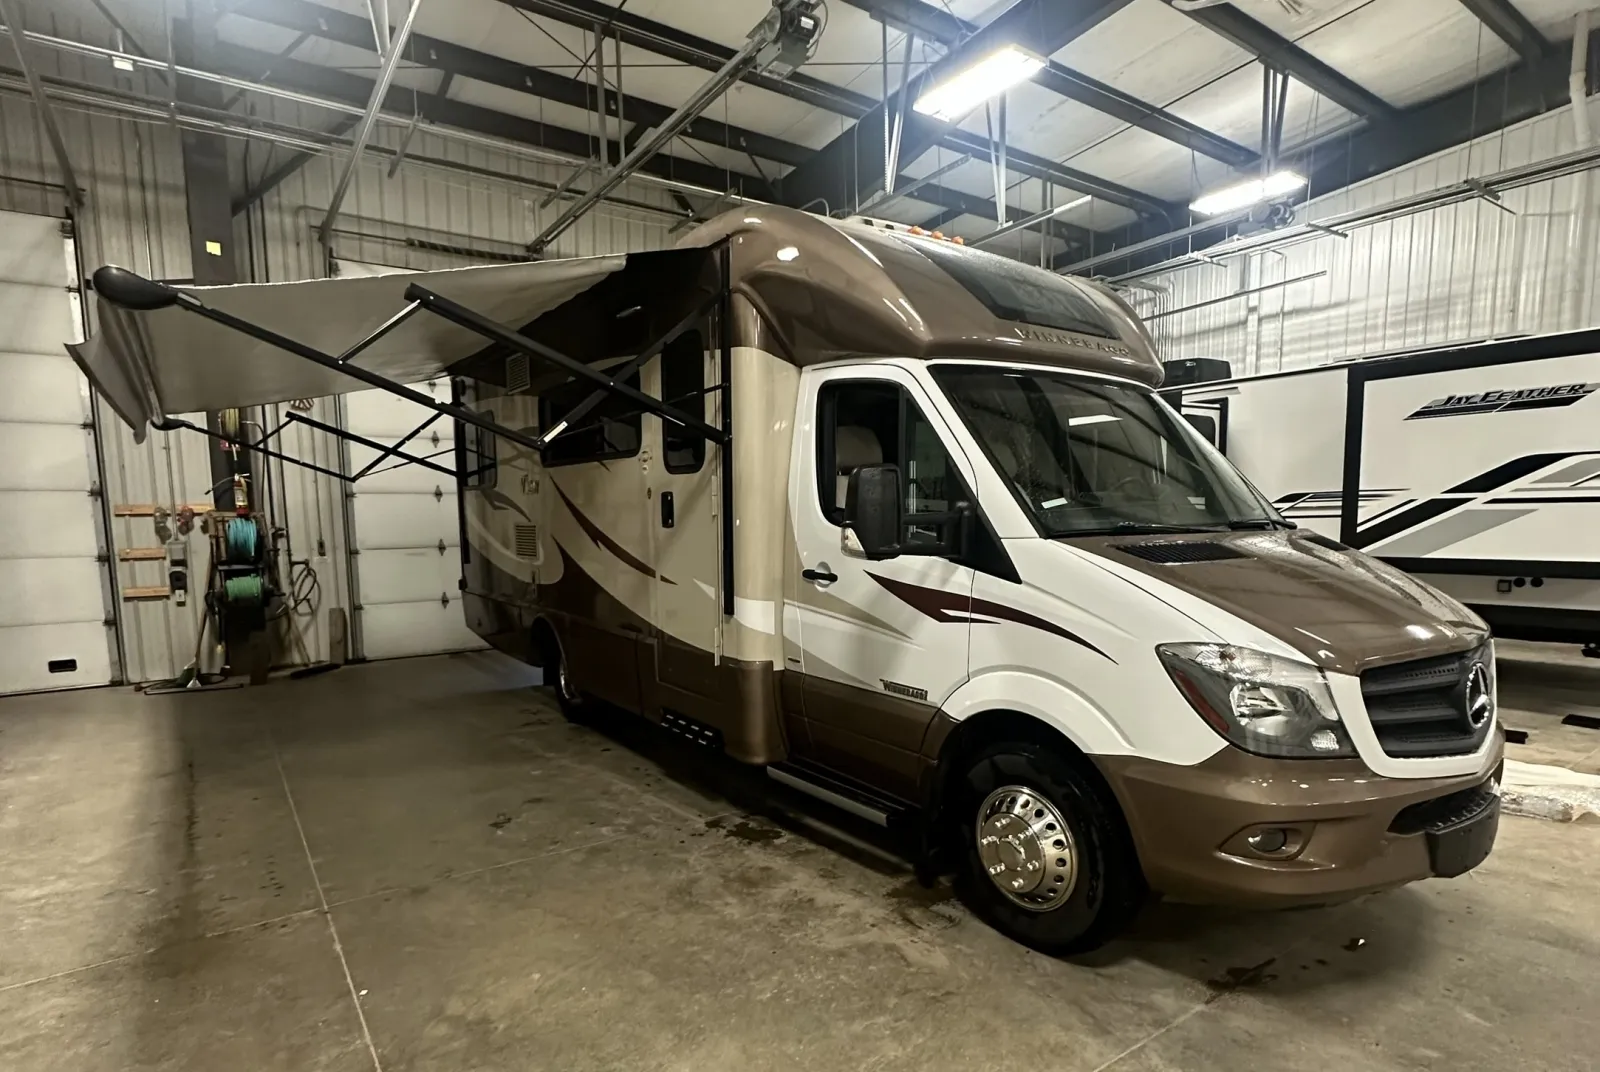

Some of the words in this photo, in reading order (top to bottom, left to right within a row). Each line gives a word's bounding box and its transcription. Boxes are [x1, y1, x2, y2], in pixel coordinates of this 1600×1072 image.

[1014, 327, 1130, 357] WINNEBAGO
[1436, 394, 1480, 407] JAY
[1479, 382, 1587, 403] FEATHER
